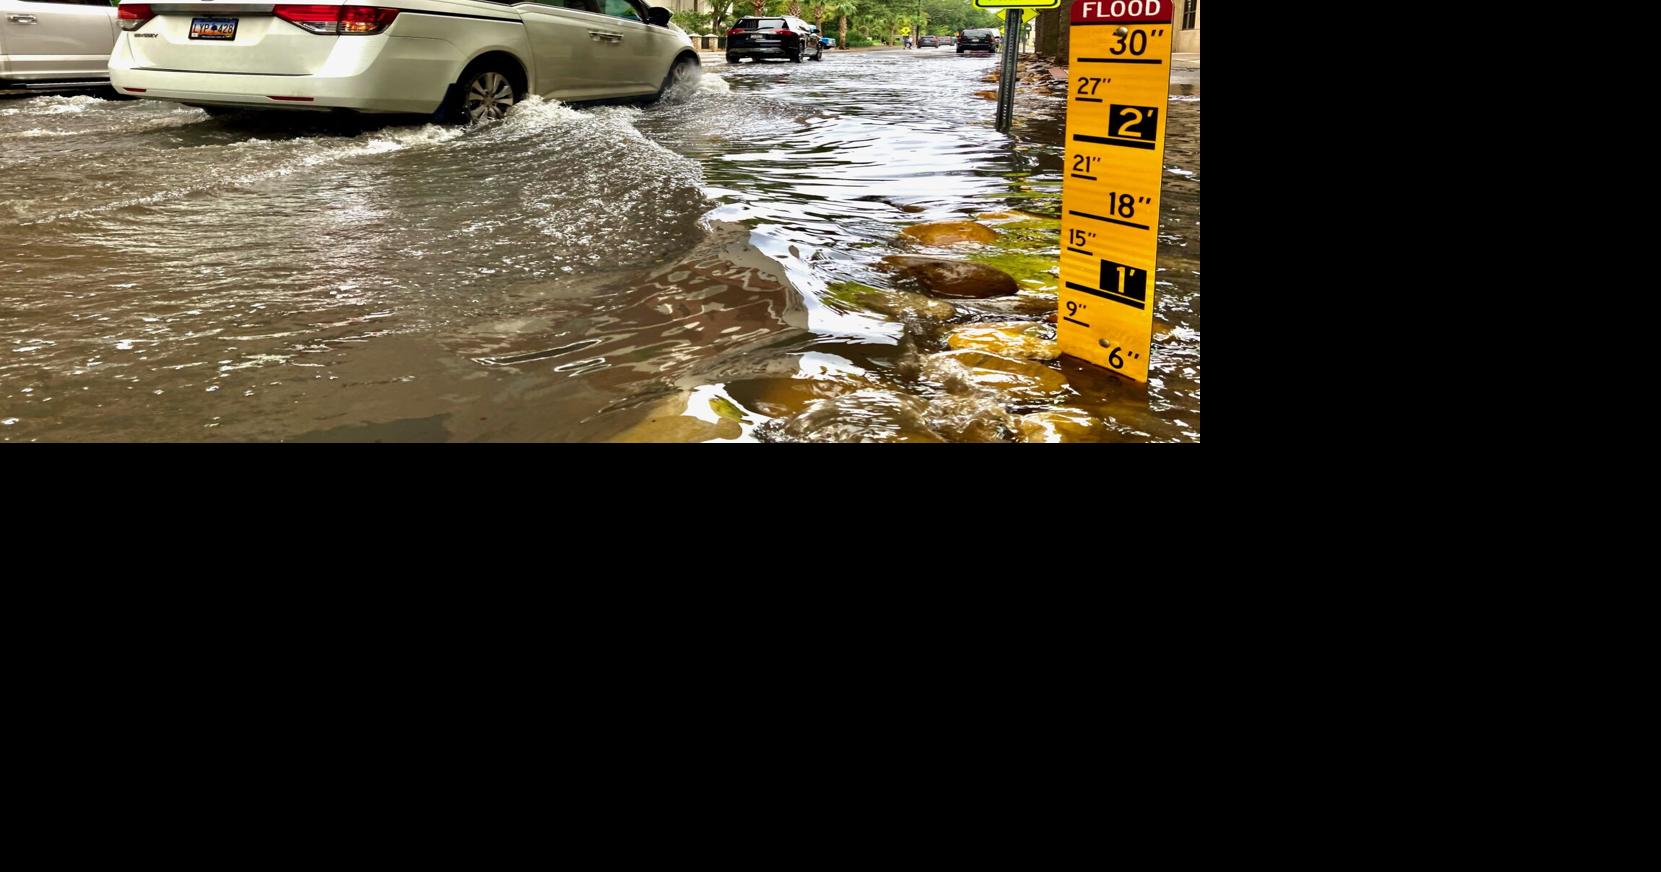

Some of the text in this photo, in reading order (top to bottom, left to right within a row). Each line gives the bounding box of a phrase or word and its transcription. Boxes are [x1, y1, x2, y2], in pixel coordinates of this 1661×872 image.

[1082, 0, 1161, 18] FLOOD
[1077, 77, 1111, 95] 27"
[1072, 154, 1101, 173] 21"
[1109, 191, 1151, 219] 18"
[1068, 228, 1096, 247] 15"
[1066, 301, 1087, 317] 9"
[1108, 346, 1139, 369] 6"
